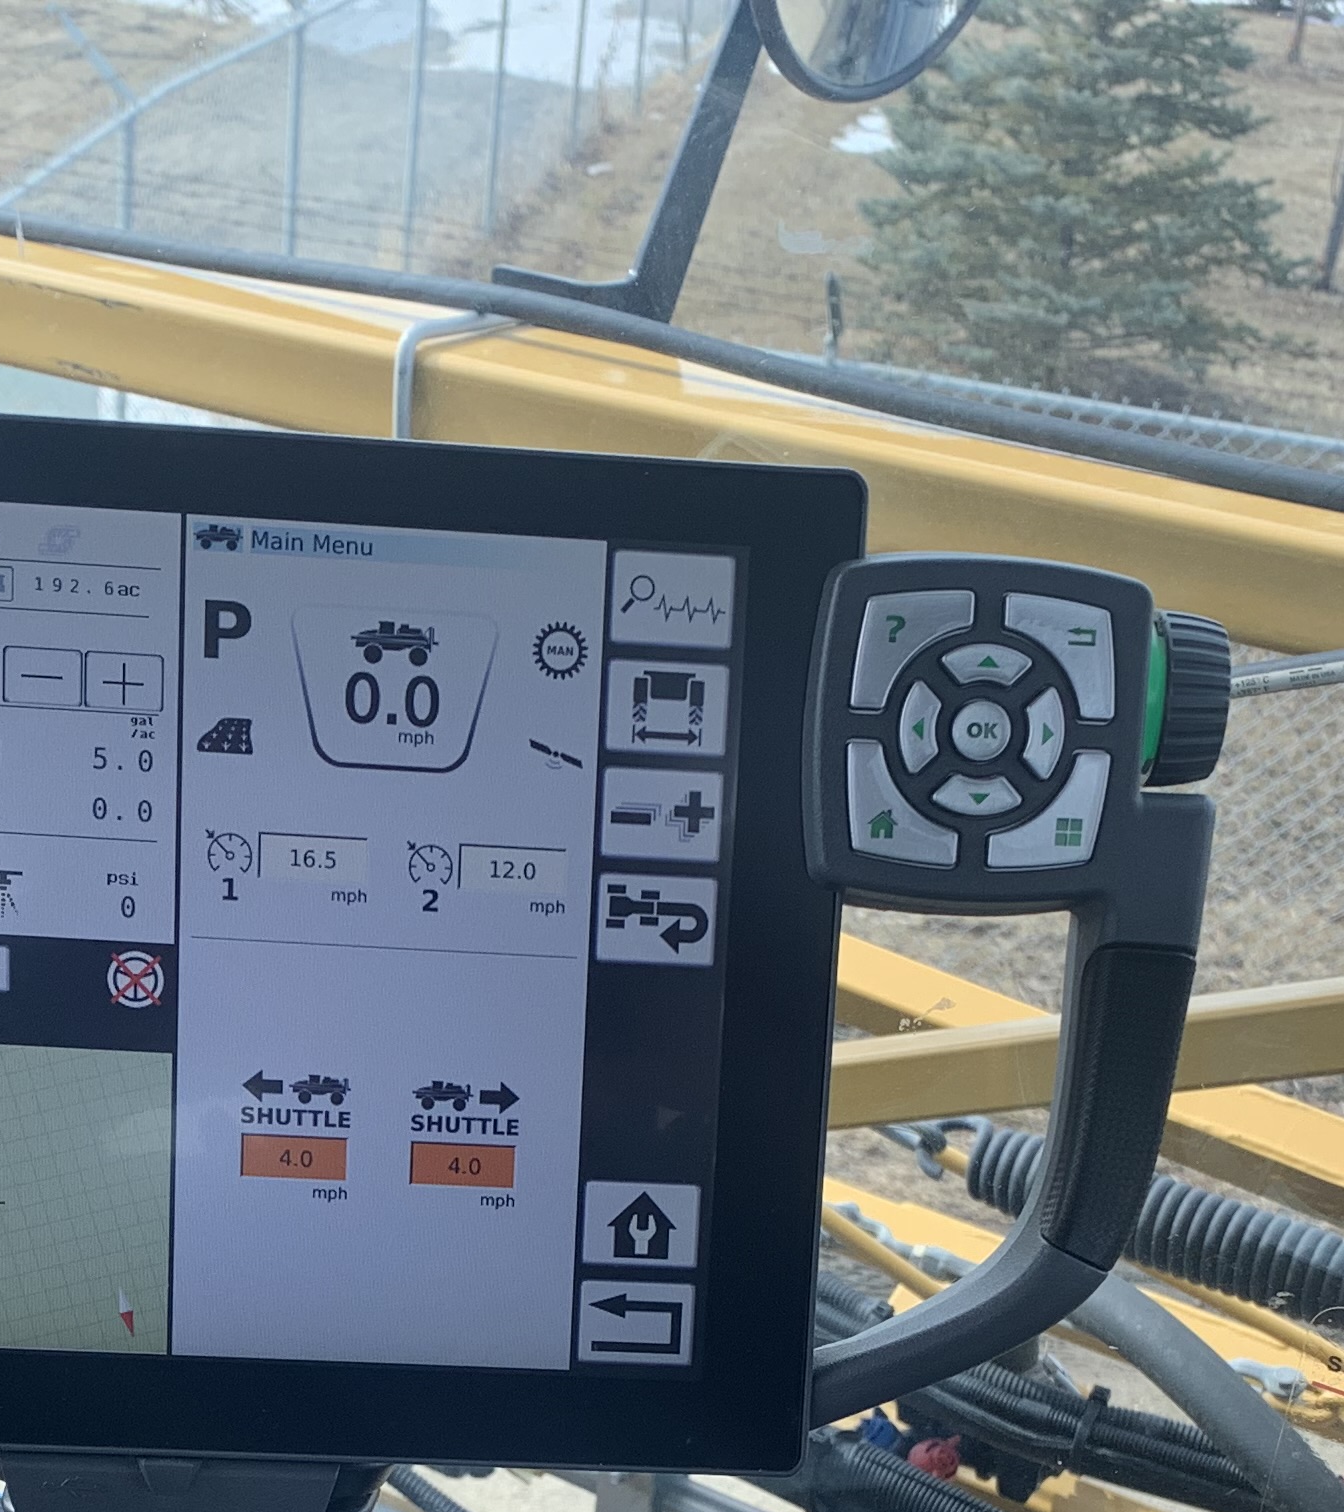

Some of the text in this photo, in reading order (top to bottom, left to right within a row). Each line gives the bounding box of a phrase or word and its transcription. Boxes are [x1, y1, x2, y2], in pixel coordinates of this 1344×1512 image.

[250, 530, 373, 558] Main Menu
[203, 599, 252, 659] P
[546, 644, 574, 657] MAN
[344, 671, 440, 728] 0.0
[130, 716, 154, 729] gal
[966, 721, 998, 740] OK
[130, 729, 156, 740] /ac
[397, 730, 435, 747] mph
[92, 747, 154, 774] 5.0
[92, 797, 154, 823] 0.0
[289, 848, 337, 869] 16.5
[106, 870, 139, 888] psi
[489, 860, 536, 880] 12.0
[221, 878, 239, 901] 1
[330, 888, 368, 905] mph
[120, 896, 137, 919] 0
[421, 889, 439, 912] 2
[529, 899, 566, 916] mph
[240, 1105, 352, 1129] SHUTTLE
[409, 1114, 520, 1137] SHUTTLE
[278, 1149, 314, 1168] 4.0
[447, 1157, 482, 1176] 4.0
[311, 1185, 349, 1203] mph
[479, 1193, 516, 1210] mph
